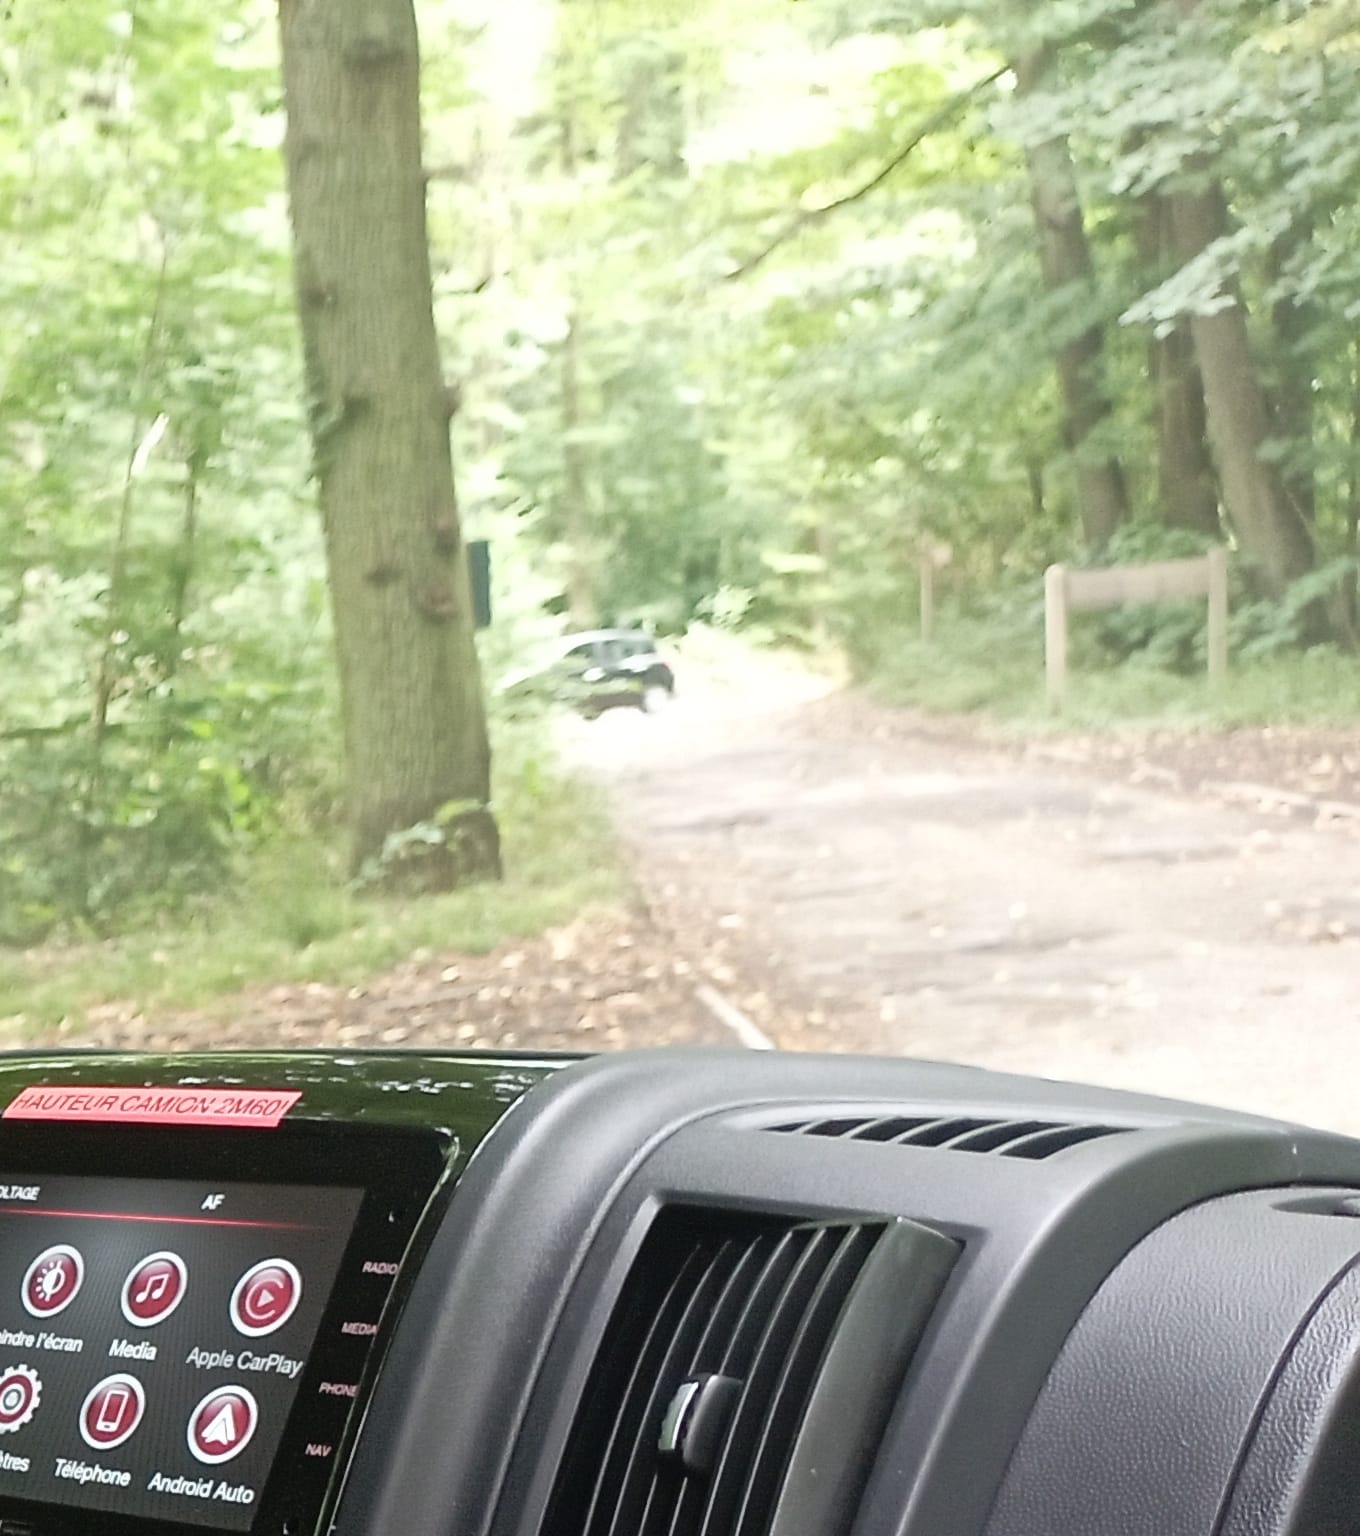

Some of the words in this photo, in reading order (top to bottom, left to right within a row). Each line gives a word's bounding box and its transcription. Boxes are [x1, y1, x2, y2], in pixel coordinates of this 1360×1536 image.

[13, 1094, 119, 1111] HAUTEUR
[121, 1096, 217, 1113] CAMION
[201, 1193, 225, 1211] AF
[362, 1261, 400, 1276] RADIO
[341, 1321, 379, 1335] MEDIA
[36, 1332, 84, 1352] l'écran
[108, 1339, 157, 1360] Media
[186, 1347, 234, 1370] Apple
[237, 1351, 304, 1379] CarPlay
[318, 1381, 359, 1398] PHONE
[305, 1443, 332, 1457] NAV
[54, 1458, 131, 1487] Téléphone
[147, 1472, 212, 1499] Android
[213, 1481, 255, 1504] Auto
